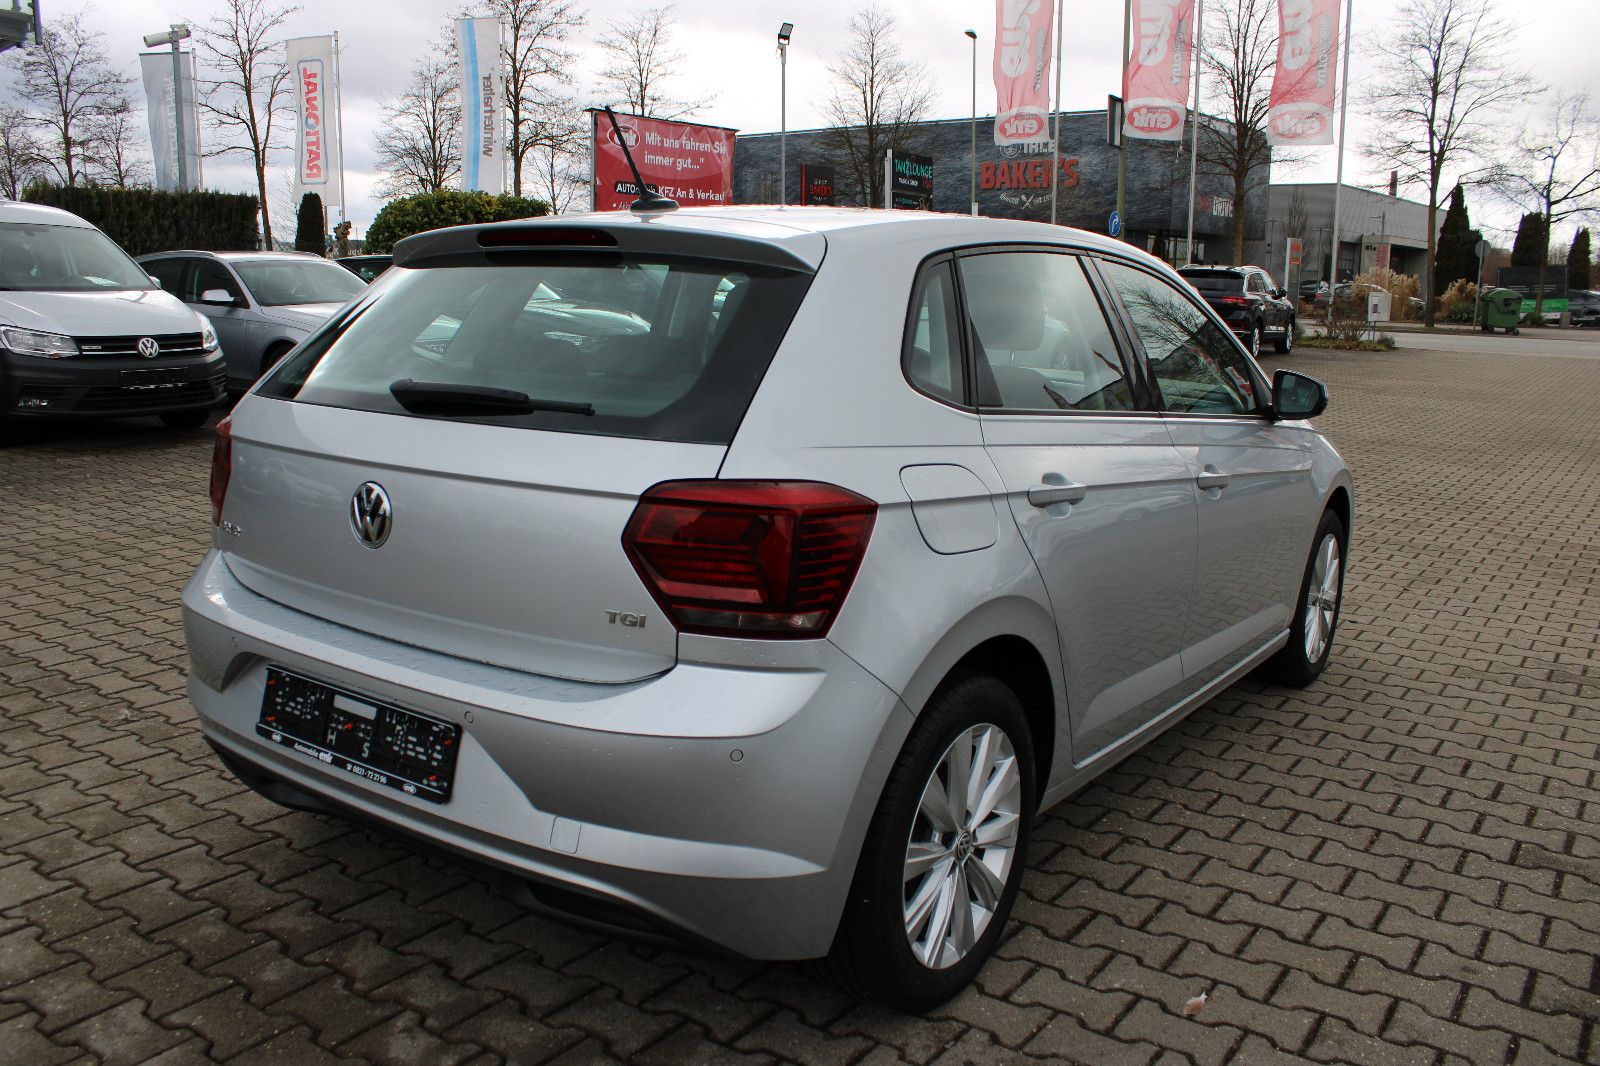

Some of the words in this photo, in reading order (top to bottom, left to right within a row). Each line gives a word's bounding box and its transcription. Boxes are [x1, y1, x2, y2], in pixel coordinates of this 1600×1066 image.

[645, 131, 661, 146] Mit
[663, 138, 680, 149] uns
[681, 137, 711, 152] fahren
[644, 151, 674, 165] immer
[676, 188, 687, 198] An
[689, 189, 695, 198] &
[605, 609, 647, 628] TGI
